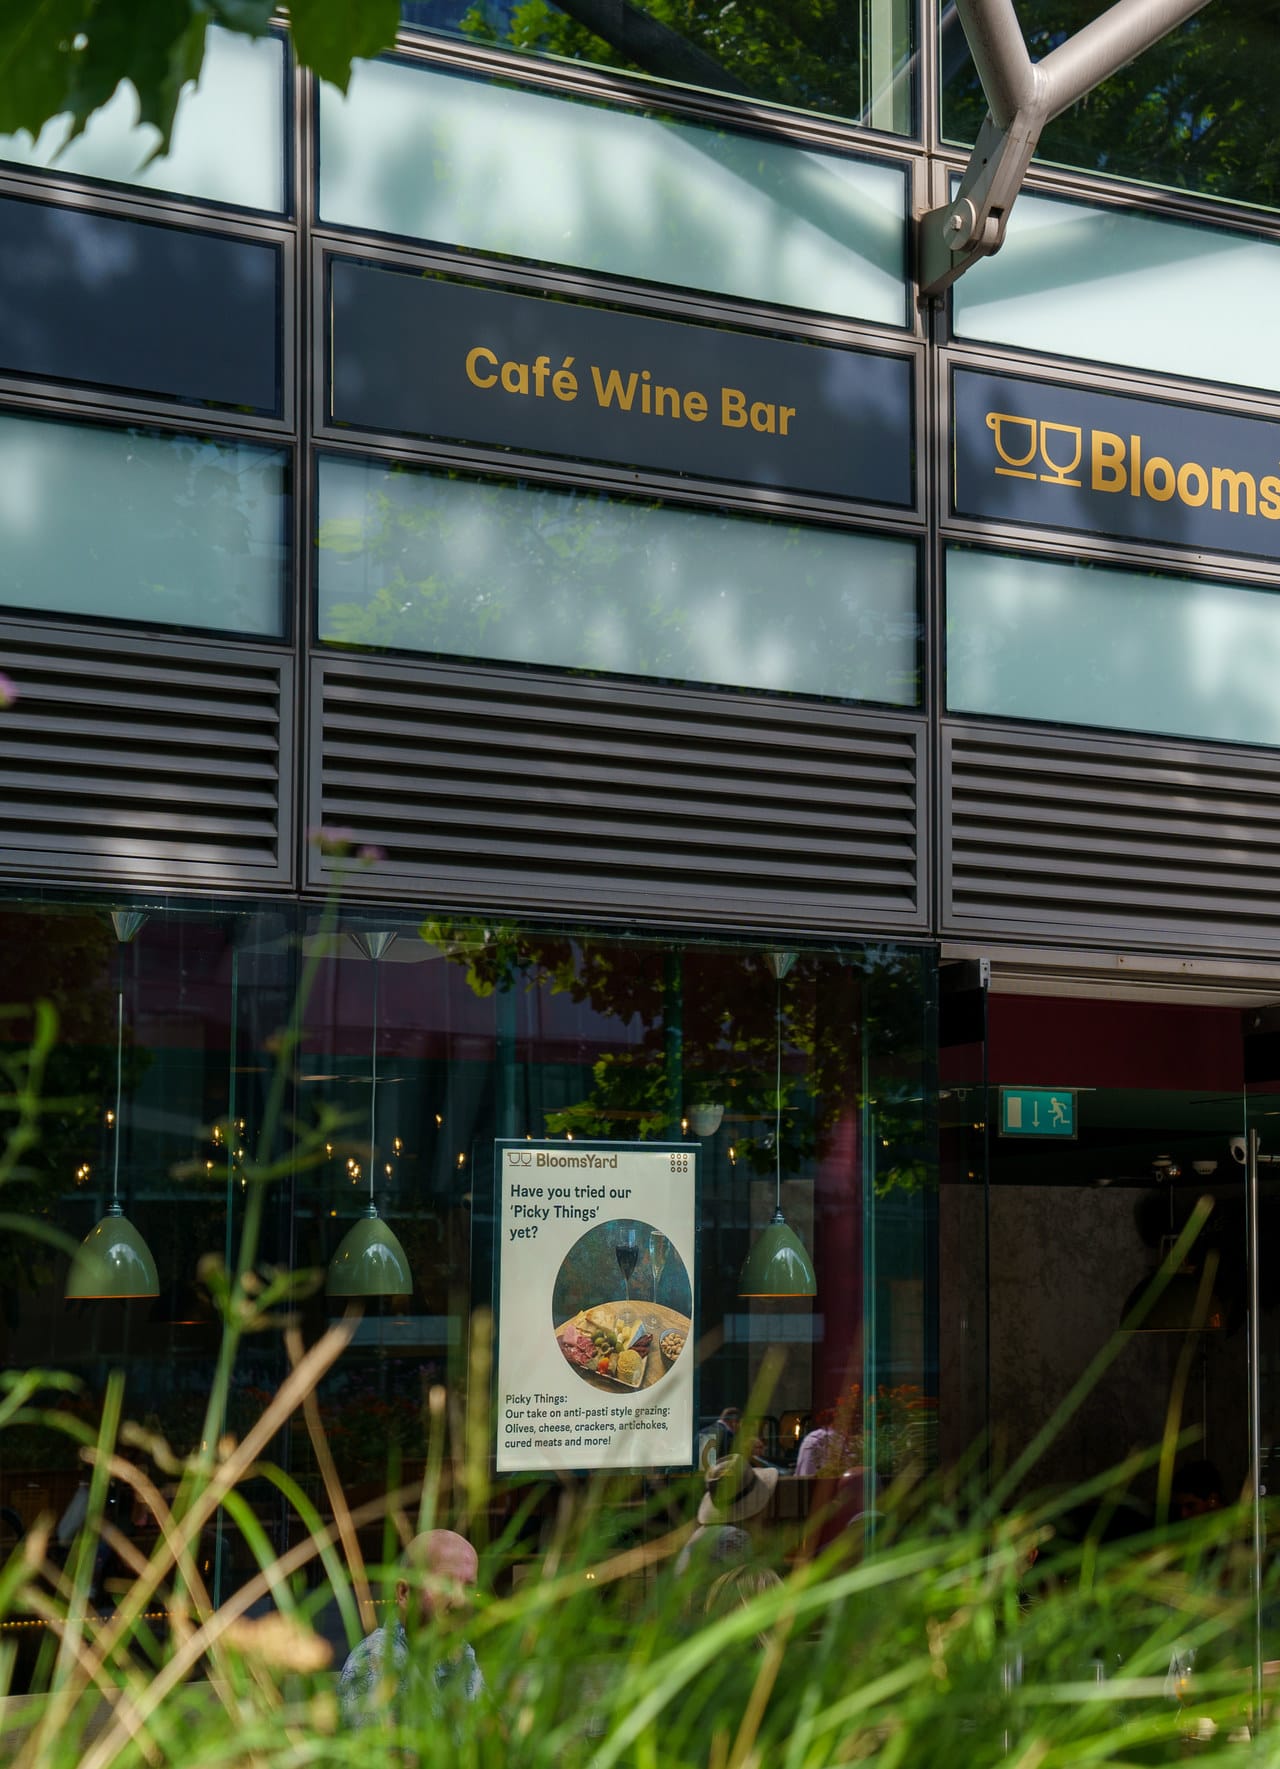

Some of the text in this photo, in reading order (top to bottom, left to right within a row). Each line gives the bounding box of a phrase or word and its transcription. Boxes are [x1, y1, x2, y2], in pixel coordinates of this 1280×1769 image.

[465, 347, 797, 436] Café Wine Bar
[536, 1152, 618, 1169] BloomsYard
[510, 1184, 632, 1201] Have you tried our
[509, 1225, 538, 1241] yet?
[505, 1393, 568, 1406] Picky Things:
[505, 1406, 671, 1420] Our take on anti-pasti style grazing:
[504, 1420, 669, 1434] Olives, cheese, crackers, artichokes,
[504, 1436, 612, 1448] cured meats and more!
